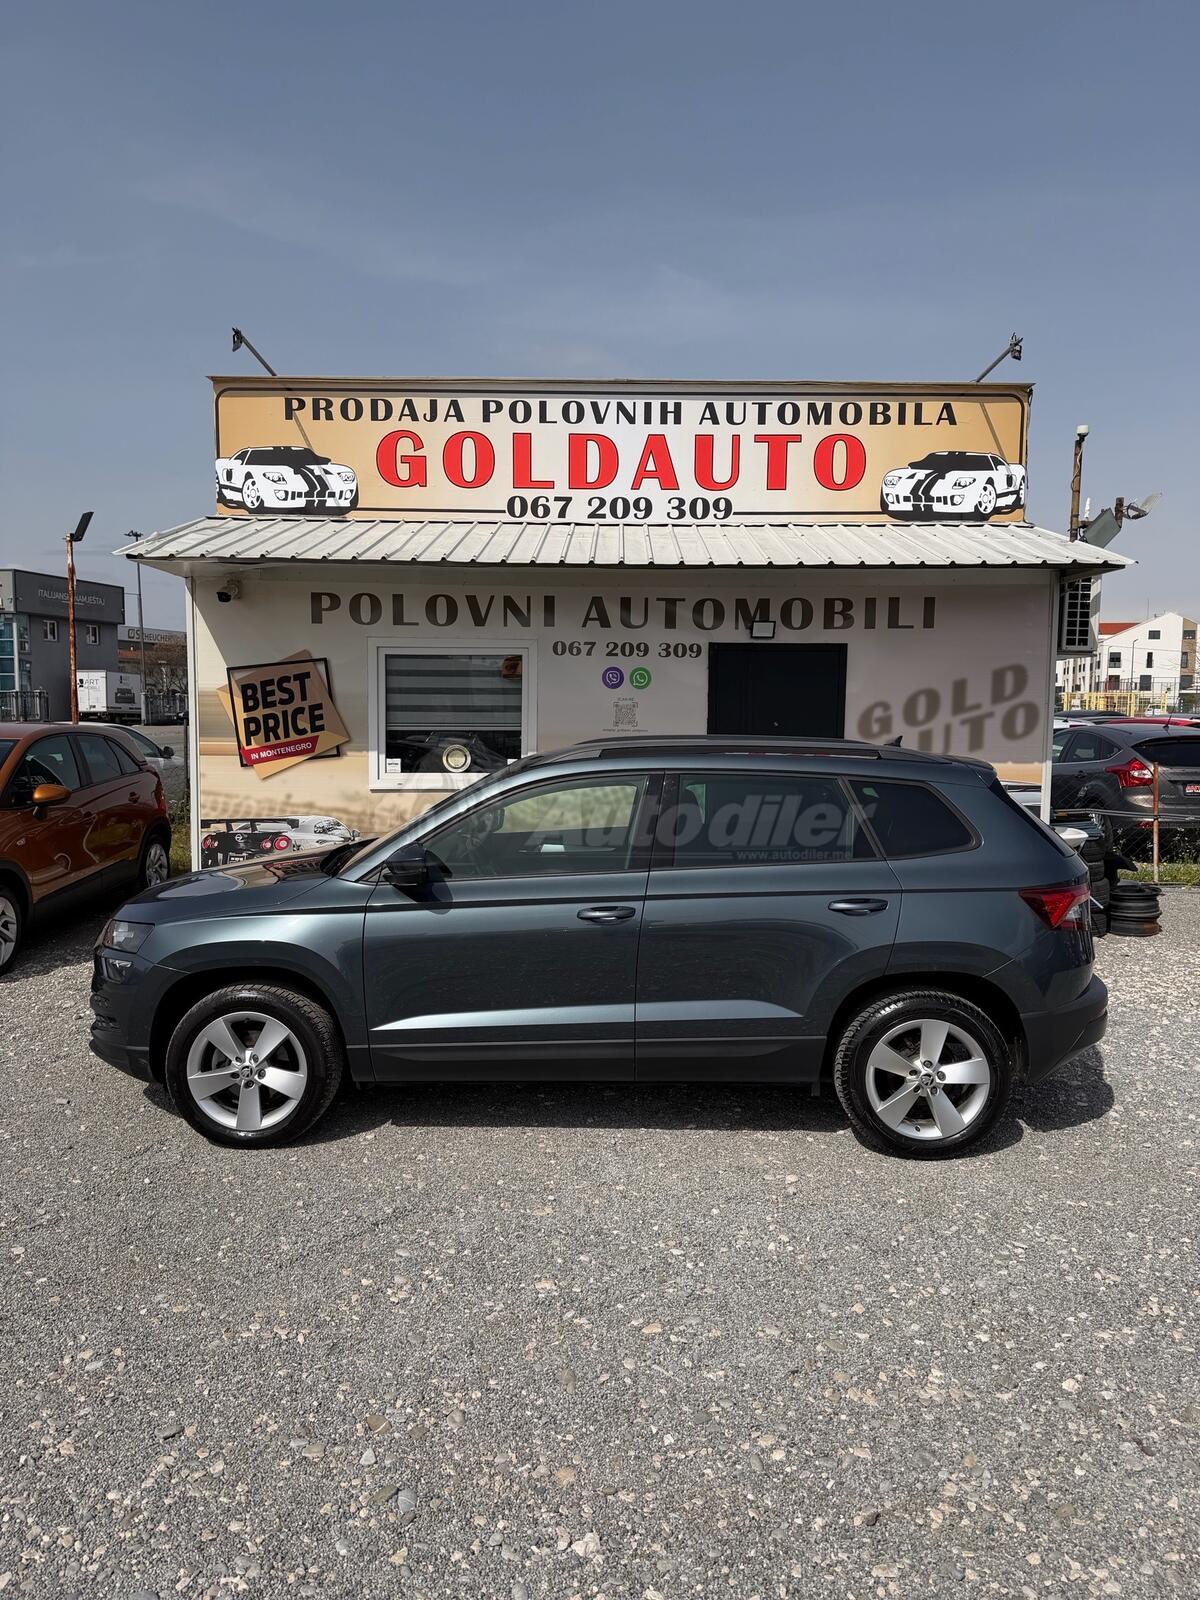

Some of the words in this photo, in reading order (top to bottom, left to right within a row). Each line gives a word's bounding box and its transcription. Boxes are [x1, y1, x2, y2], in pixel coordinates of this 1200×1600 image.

[284, 397, 465, 423] PRODAJA
[482, 399, 682, 426] POLOVNIH
[698, 401, 958, 427] AUTOMOBILA
[376, 430, 867, 492] GOLDAUTO
[506, 495, 573, 520] 067
[587, 496, 653, 521] 209
[666, 497, 733, 521] 309
[310, 591, 556, 628] POLOVNI
[581, 596, 937, 631] AUTOMOBILI
[551, 640, 597, 657] 067
[605, 641, 650, 658] 209
[657, 642, 703, 659] 309
[240, 671, 311, 713] BEST
[857, 663, 1030, 741] GOLD
[243, 702, 325, 747] PRICE
[915, 700, 1040, 754] UTO
[250, 752, 259, 760] IN
[260, 742, 312, 758] MONTENEGRO
